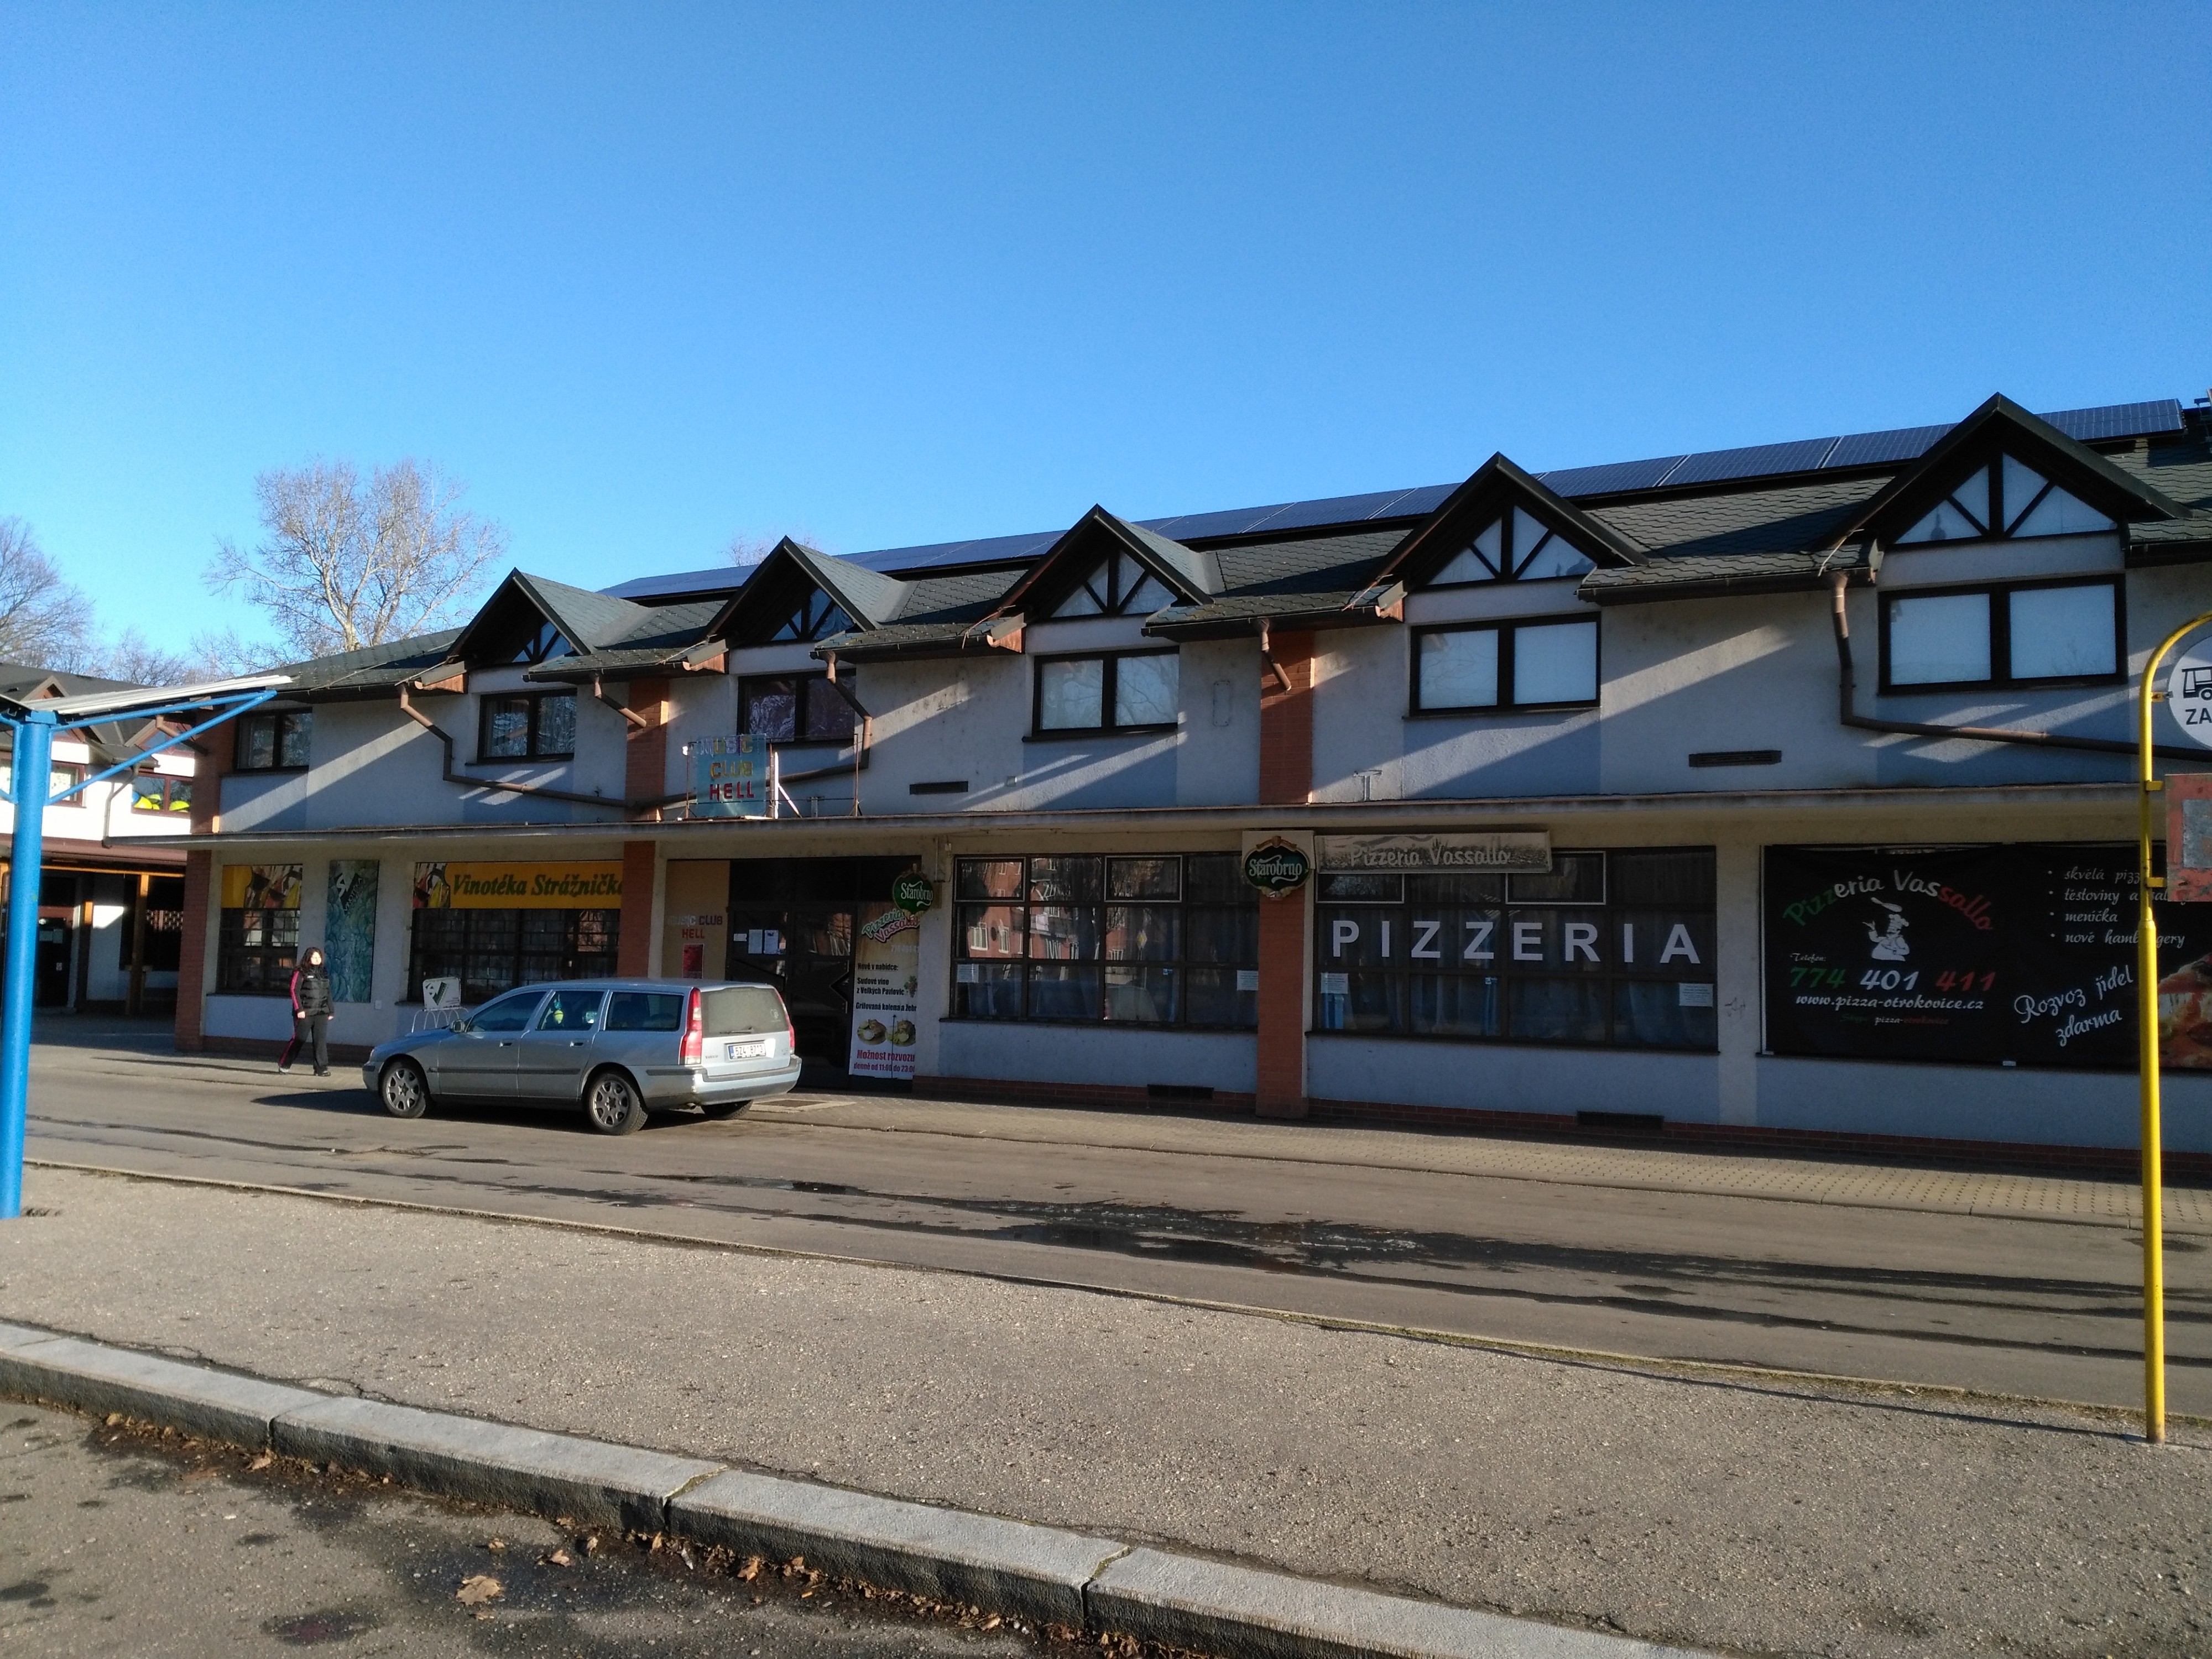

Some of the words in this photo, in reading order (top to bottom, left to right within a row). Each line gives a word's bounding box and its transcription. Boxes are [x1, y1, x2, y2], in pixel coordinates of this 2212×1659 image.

[700, 737, 753, 757] MUSIC
[710, 760, 753, 779] CLUB
[709, 781, 754, 801] HELL
[1349, 844, 1422, 867] Pizzeria
[1429, 844, 1512, 865] Vassallo
[1249, 854, 1302, 884] Starobrno
[2115, 869, 2140, 884] pizz
[452, 874, 527, 896] Vinotéka
[900, 880, 933, 907] Starobrno
[1782, 875, 1885, 926] Pizzeria
[1893, 869, 1992, 930] Vassallo
[2064, 888, 2120, 905] těstoviny
[2129, 891, 2139, 901] a
[699, 915, 723, 925] CLUB
[862, 908, 904, 938] Pizzeria
[682, 928, 705, 940] HELL
[1332, 920, 1702, 964] PIZZERIA
[2064, 932, 2095, 943] nové
[2104, 929, 2185, 948] hambgery
[1790, 967, 1846, 989] 774
[1859, 969, 1919, 991] 401
[1936, 970, 1996, 992] 411
[1795, 994, 1984, 1011] www.pizza-otrokovice.cz
[2013, 994, 2086, 1024] Rozvoz
[2095, 964, 2134, 1001] jídel
[855, 1002, 881, 1010] Grilovaná
[882, 1003, 900, 1011] kolena
[2056, 1009, 2123, 1047] zdarma
[857, 1050, 886, 1061] Možnost
[888, 1052, 915, 1062] rozvozu
